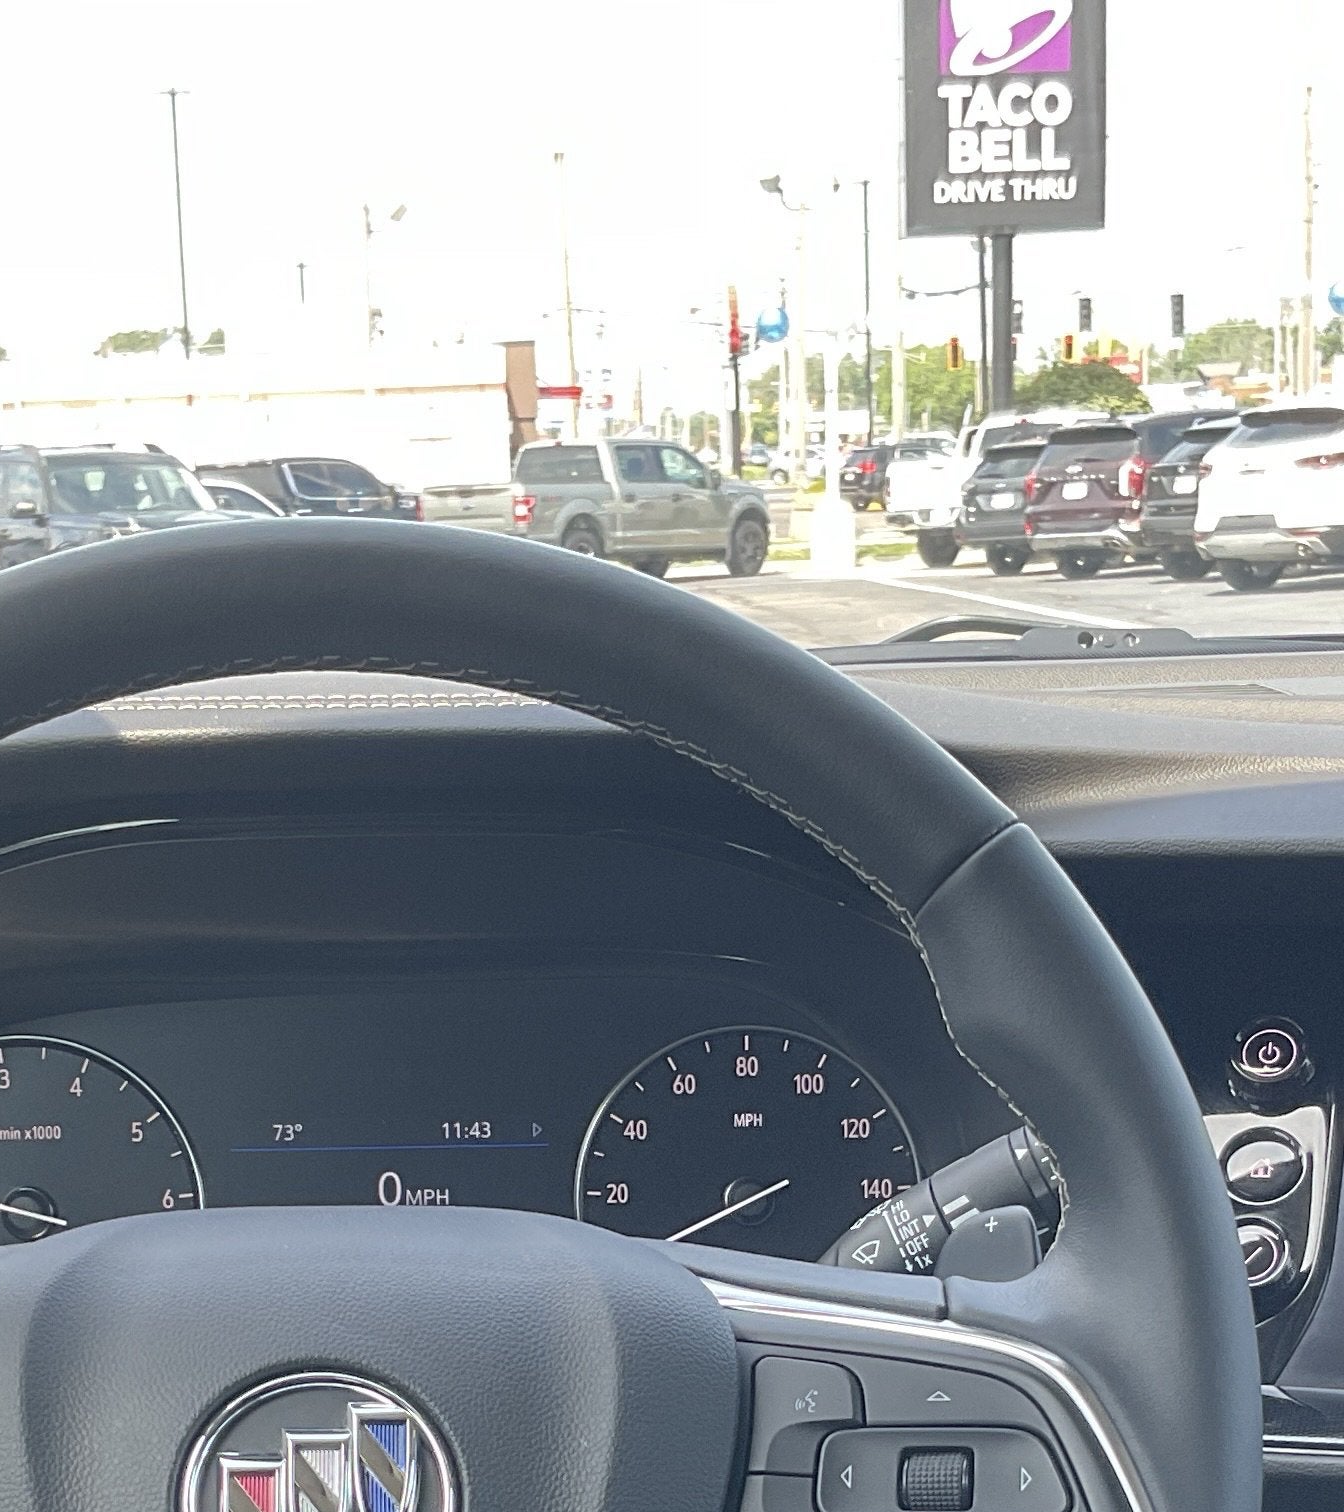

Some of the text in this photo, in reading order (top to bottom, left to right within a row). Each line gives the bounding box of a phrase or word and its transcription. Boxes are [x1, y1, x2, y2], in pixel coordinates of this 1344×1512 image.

[937, 81, 1073, 128] TACO
[948, 127, 1071, 174] BELL
[933, 177, 1077, 204] DRIVE THRU
[735, 1056, 759, 1077] 80
[69, 1076, 83, 1098] 4
[672, 1073, 696, 1095] 60
[793, 1073, 825, 1095] 100
[441, 1121, 491, 1140] 11:43
[623, 1119, 648, 1140] 40
[733, 1113, 763, 1127] MPH
[840, 1118, 870, 1139] 120
[24, 1125, 62, 1140] x1000
[131, 1121, 144, 1143] 5
[272, 1123, 303, 1142] 73°
[162, 1188, 175, 1209] 6
[378, 1171, 449, 1206] 0 MPH
[606, 1183, 629, 1204] 20
[860, 1178, 893, 1199] 140
[892, 1209, 911, 1227] LO
[897, 1218, 921, 1241] INT
[905, 1232, 930, 1257] OFF
